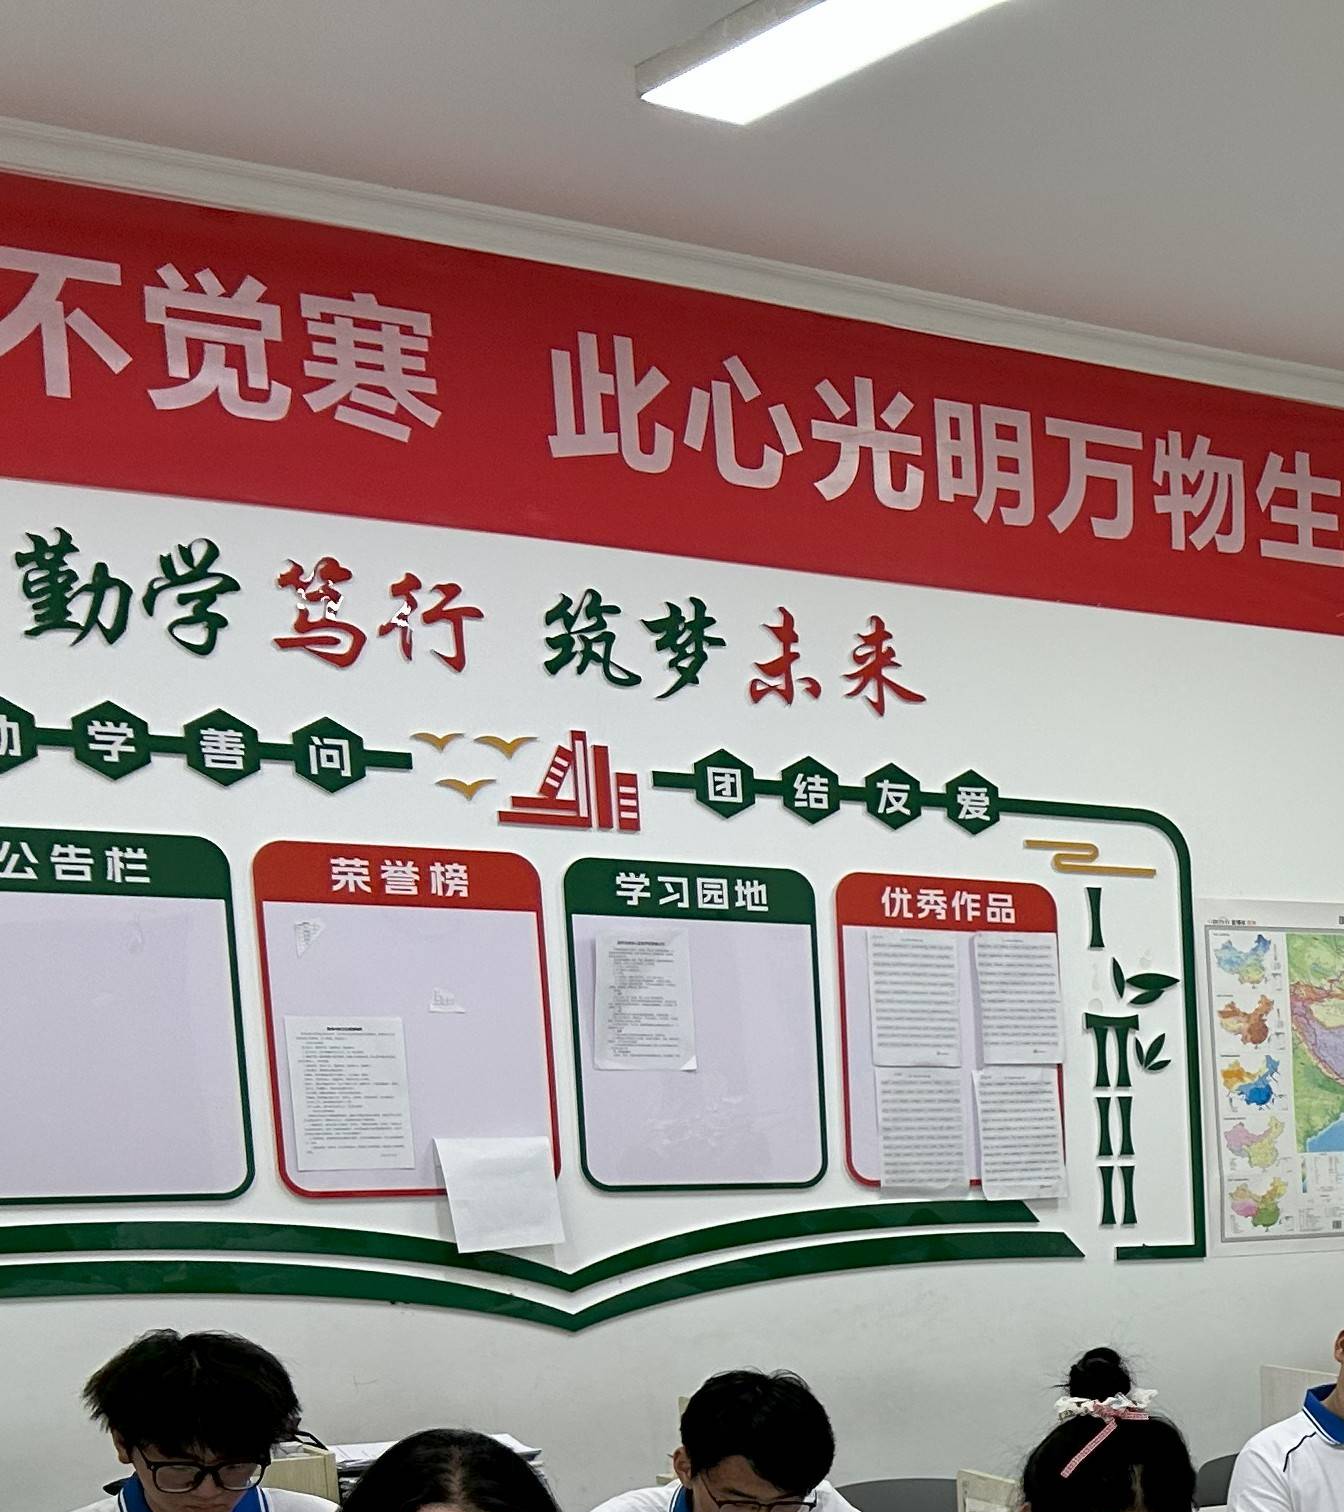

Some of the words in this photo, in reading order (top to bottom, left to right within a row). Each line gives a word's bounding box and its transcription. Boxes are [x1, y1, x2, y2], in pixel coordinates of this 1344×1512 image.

[0, 246, 442, 443] 不觉寒
[706, 766, 991, 822] 团结友爱
[0, 841, 151, 884] 公告栏
[329, 857, 470, 898] 荣誉榜
[615, 871, 770, 913] 学习园地
[881, 886, 1016, 924] 优秀作品
